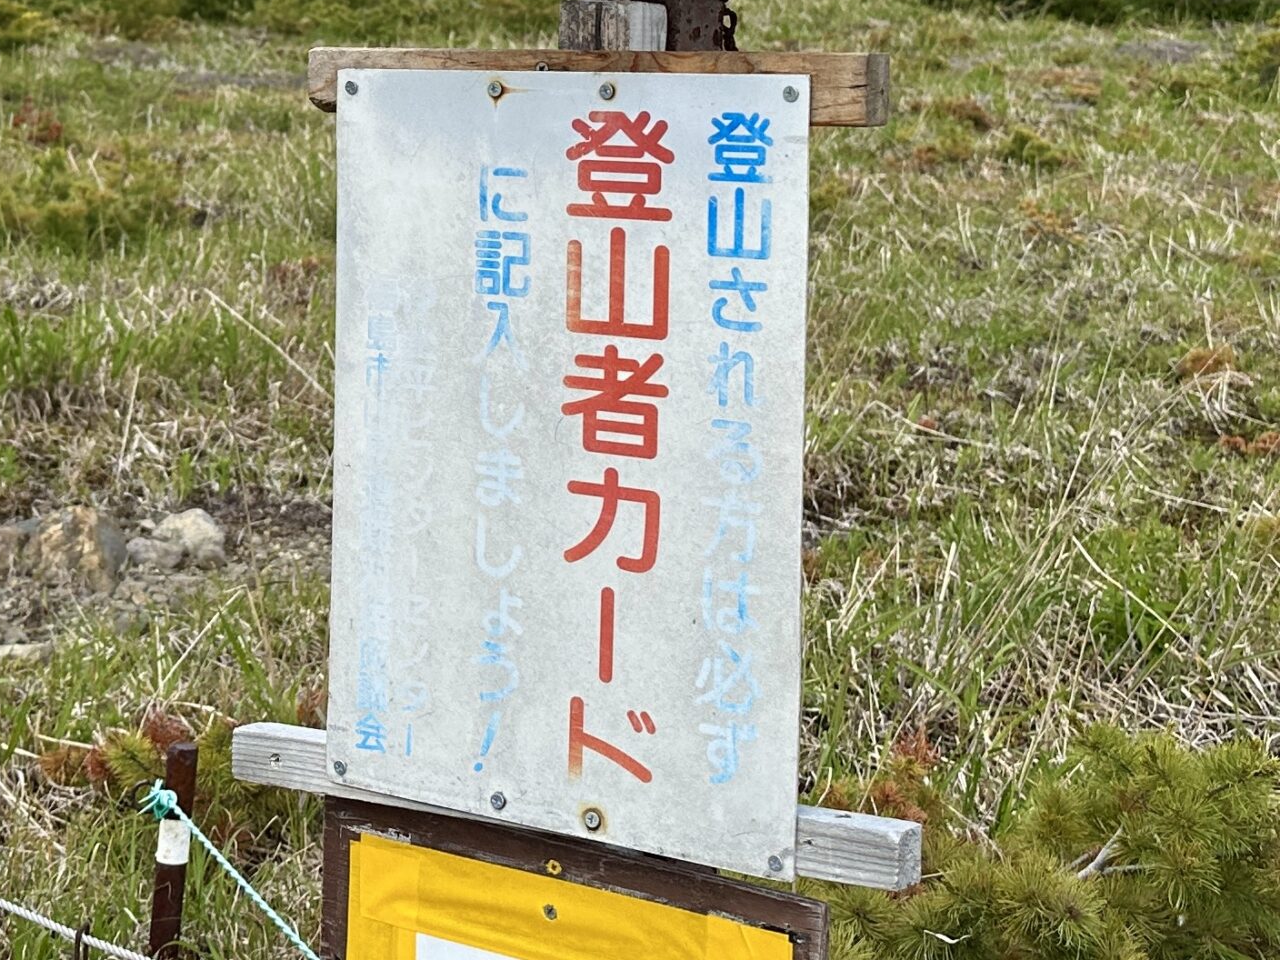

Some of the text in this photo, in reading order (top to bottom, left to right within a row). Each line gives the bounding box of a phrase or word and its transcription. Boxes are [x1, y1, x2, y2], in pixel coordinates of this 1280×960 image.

[560, 109, 675, 784] 登山者カード
[696, 112, 774, 784] 登山される方は必ず
